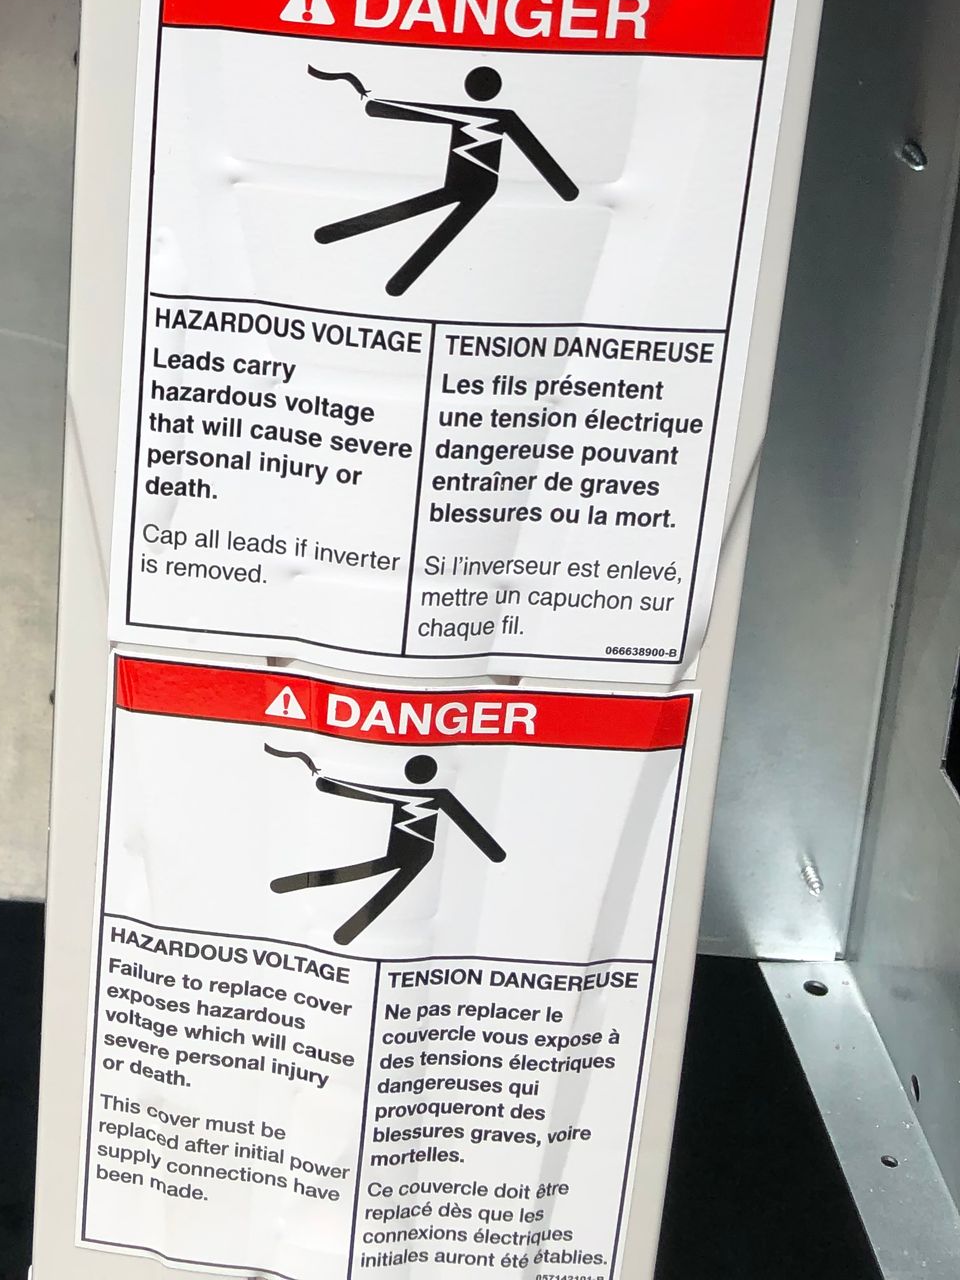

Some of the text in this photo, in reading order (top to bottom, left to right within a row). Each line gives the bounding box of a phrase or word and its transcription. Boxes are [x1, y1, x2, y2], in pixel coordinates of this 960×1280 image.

[155, 306, 423, 354] HAZARDOUS VOLTAGE
[444, 334, 715, 364] TENSION DANGEREUSE
[441, 372, 665, 402] Les fils présentent
[150, 379, 375, 427] hazardous voltage
[146, 447, 363, 486] personal injury or
[434, 438, 680, 467] dangereuse pouvant
[145, 475, 218, 500] death.
[431, 470, 660, 499] entraîner de graves
[142, 523, 401, 571] Cap all leads if inverter
[424, 555, 446, 576] Si
[567, 559, 601, 579] est
[606, 560, 682, 585] enlevé,
[421, 587, 675, 612] mettre un capuchon sur
[417, 614, 524, 642] chaque fil.
[605, 645, 678, 658] 066638900-B
[325, 693, 538, 735] DANGER
[110, 926, 351, 985] HAZARDOUS VOLTAGE
[108, 957, 353, 1017] Failure to replace cover
[387, 968, 640, 993] TENSION DANGEREUSE
[384, 1002, 564, 1024] Ne pas replacer le
[105, 1009, 355, 1067] voltage which will cause
[379, 1049, 616, 1074] des tensions électriques
[98, 1120, 351, 1180] replaced after initial power
[372, 1125, 592, 1148] blessures graves, voire
[370, 1146, 465, 1167] mortelles.
[362, 1224, 574, 1247] connexions électriques
